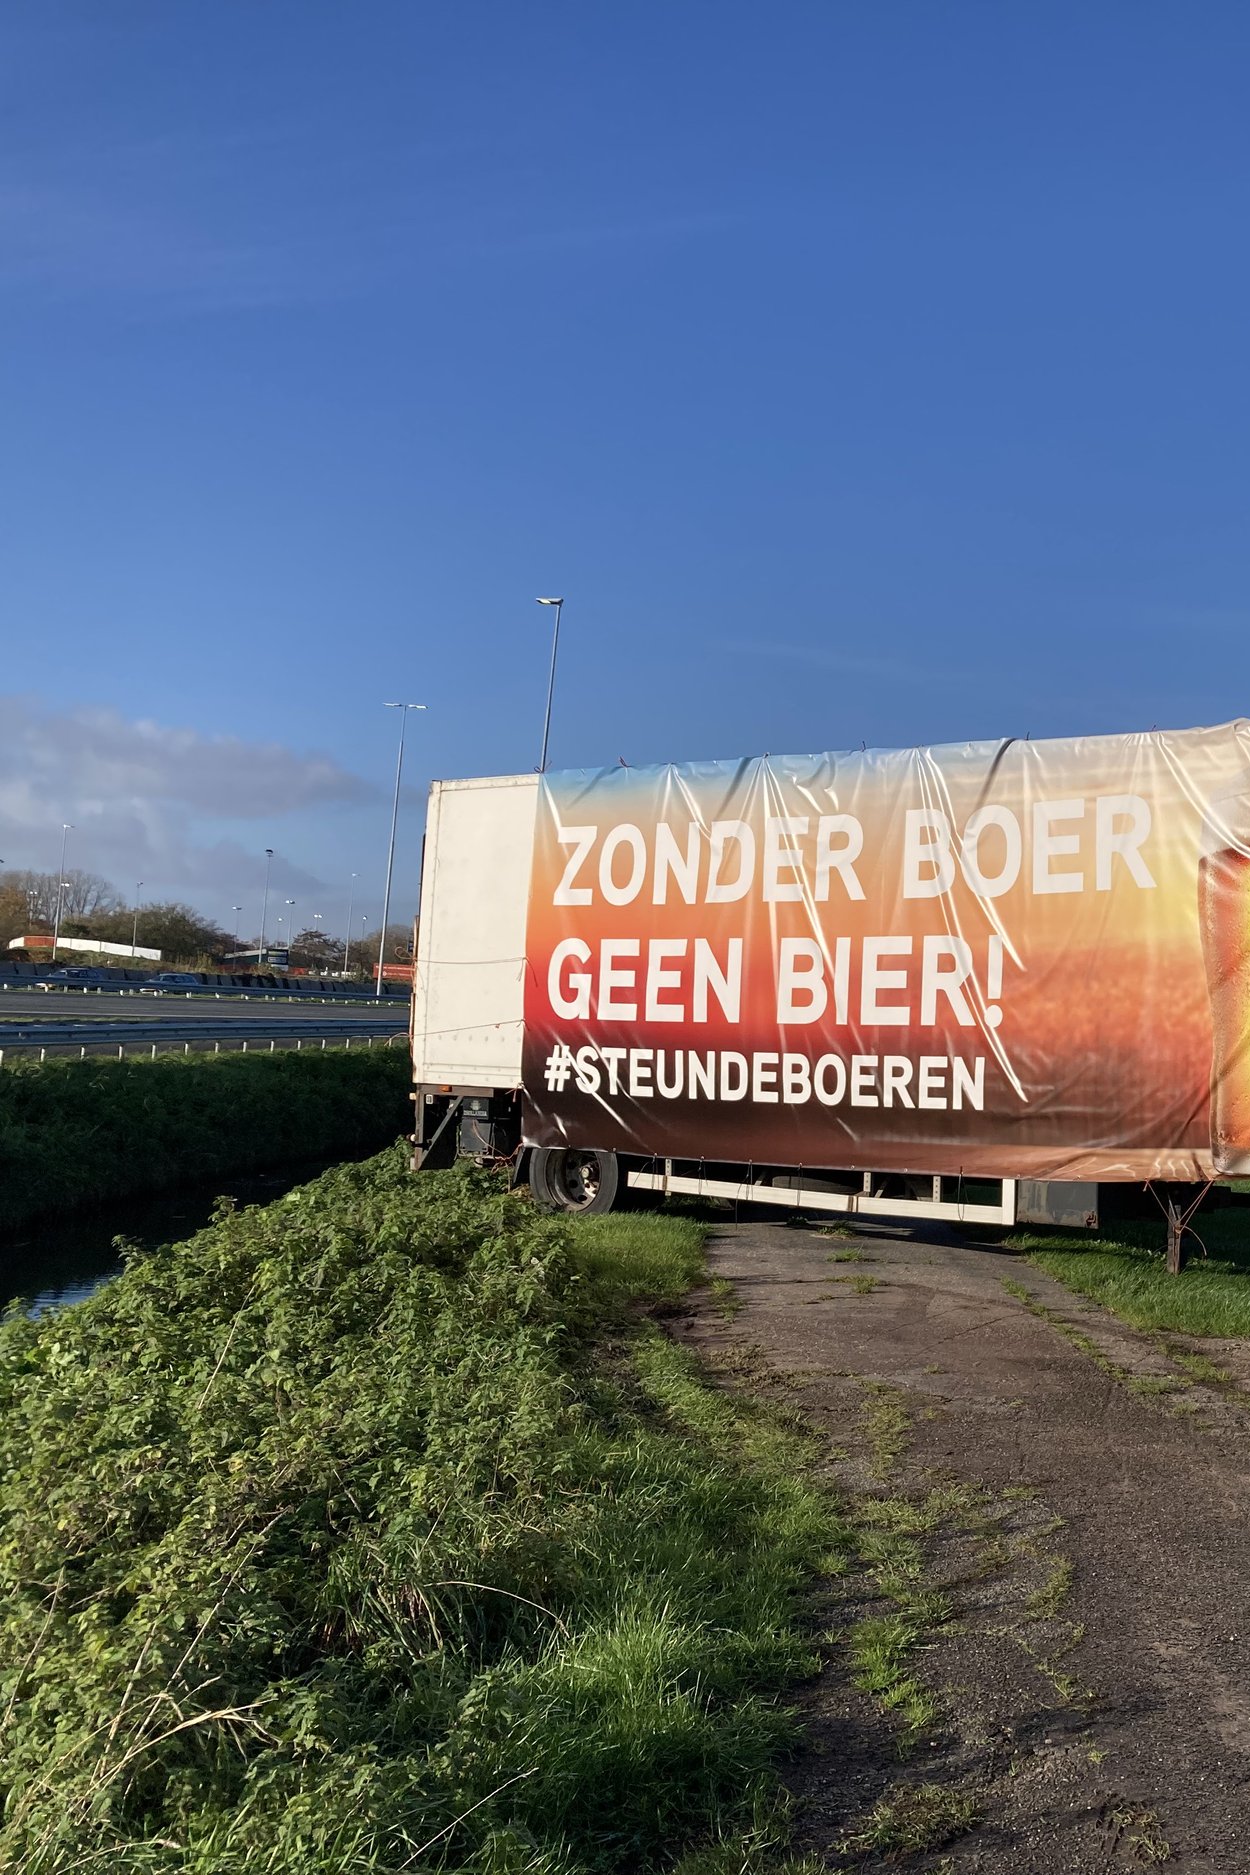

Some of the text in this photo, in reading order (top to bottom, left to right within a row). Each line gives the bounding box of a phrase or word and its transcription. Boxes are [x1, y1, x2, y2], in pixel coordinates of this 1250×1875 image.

[553, 795, 1156, 906] ZONDER BOER
[547, 934, 1003, 1028] GEEN BIER!
[544, 1044, 986, 1110] #STEUNDEBOEREN
